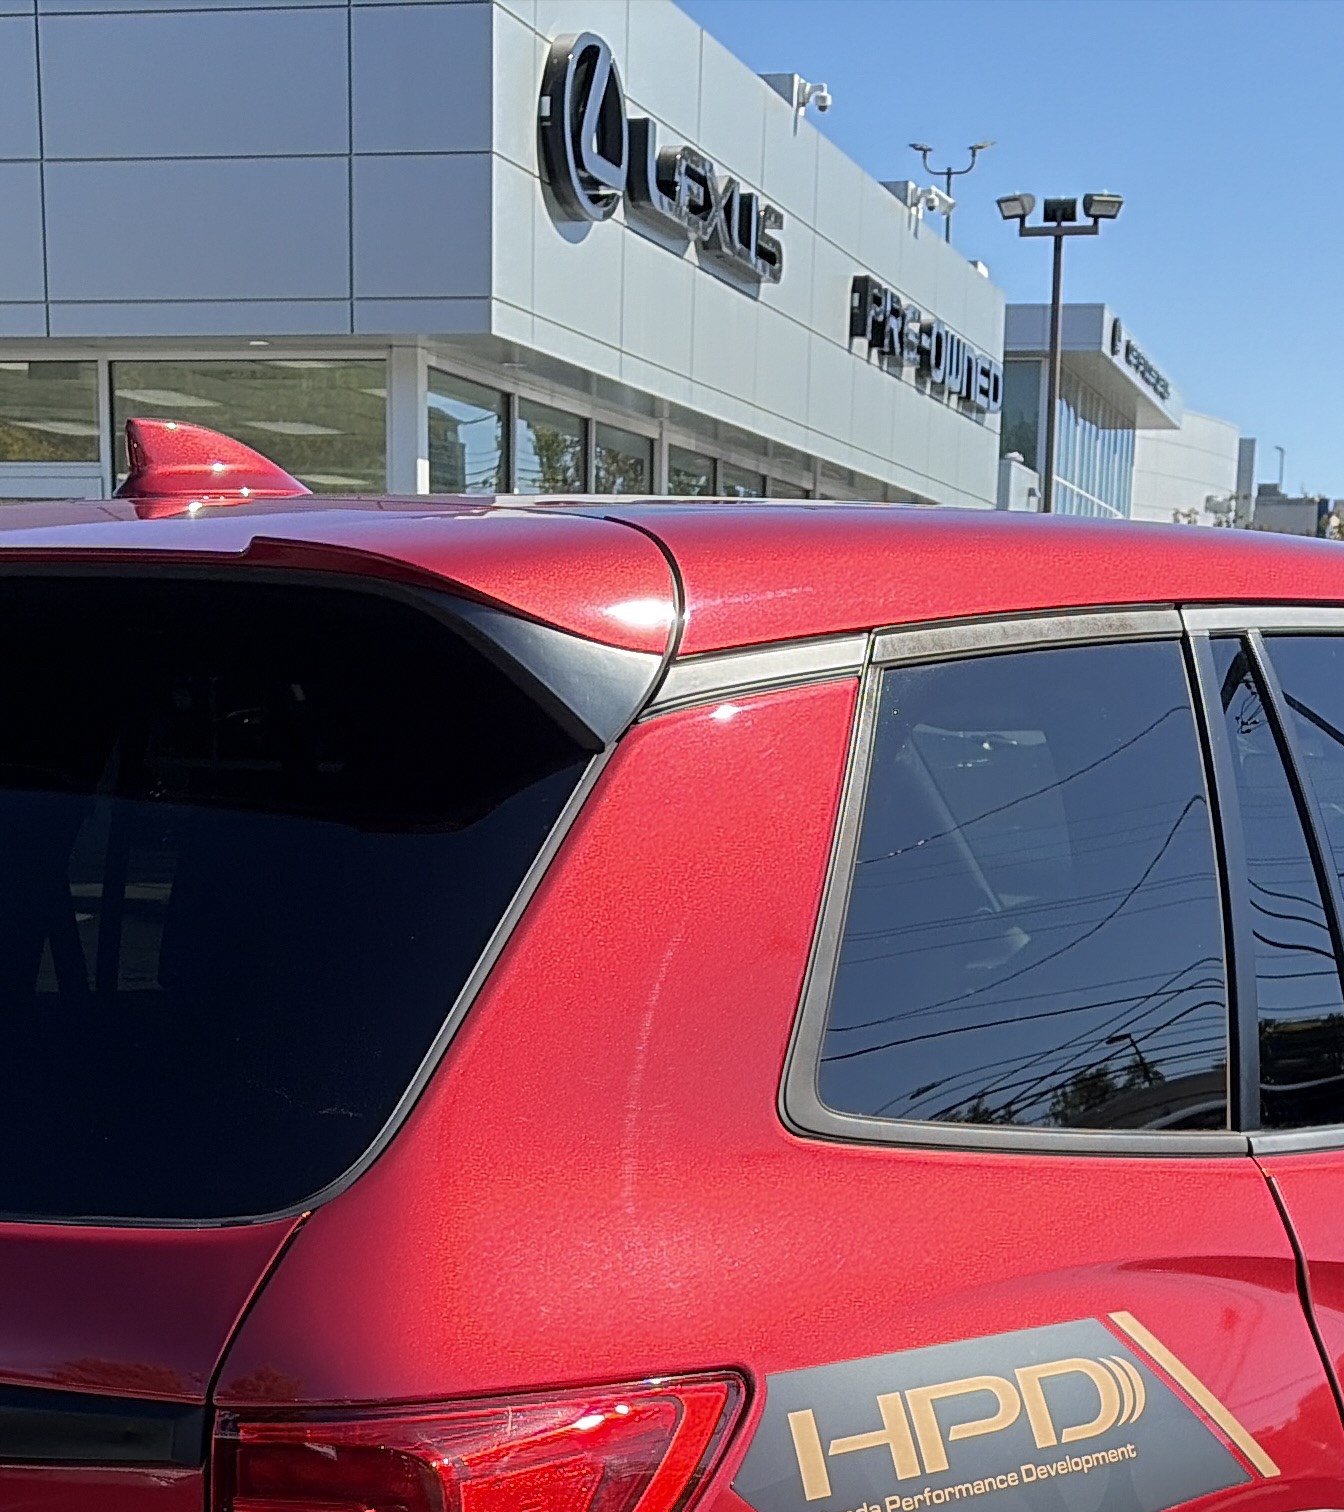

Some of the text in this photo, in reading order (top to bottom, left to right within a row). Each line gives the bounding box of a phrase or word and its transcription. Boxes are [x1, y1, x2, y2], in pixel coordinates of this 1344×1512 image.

[626, 117, 784, 284] LEXUS
[849, 275, 1004, 413] PRE-OWNED
[787, 1355, 1146, 1501] HPD
[1020, 1443, 1138, 1483] Development
